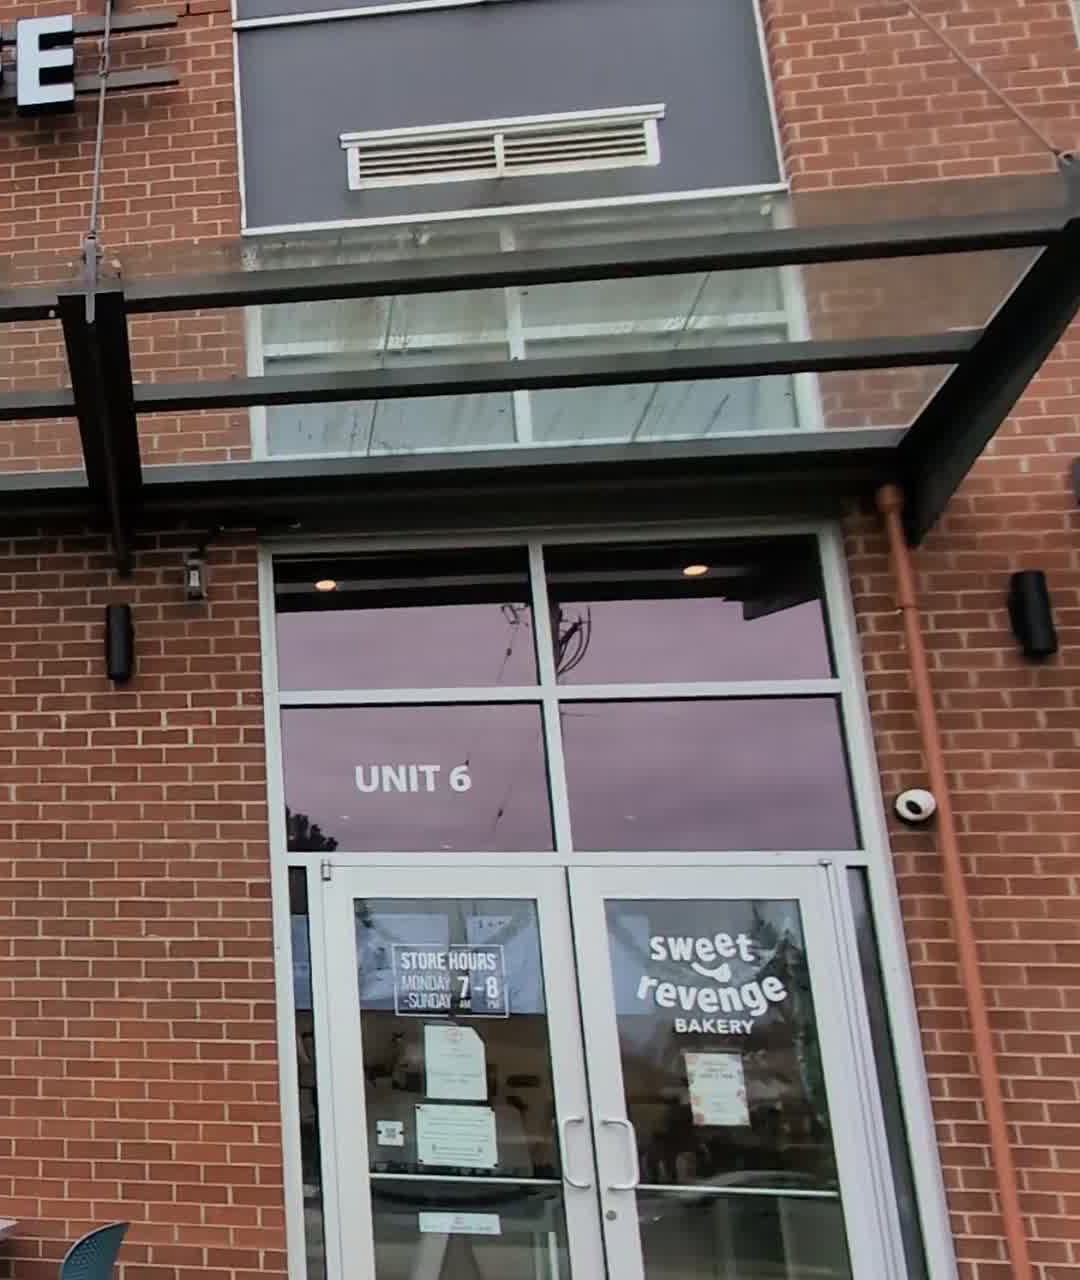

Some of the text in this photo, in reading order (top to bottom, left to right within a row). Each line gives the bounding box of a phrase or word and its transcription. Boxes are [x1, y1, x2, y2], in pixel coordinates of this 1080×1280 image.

[354, 765, 472, 793] UNIT 6
[649, 932, 757, 964] sweet
[400, 951, 497, 971] STORE HOURS
[401, 975, 451, 991] MONDAY
[637, 973, 788, 1018] revenge
[674, 1018, 755, 1036] BAKERY
